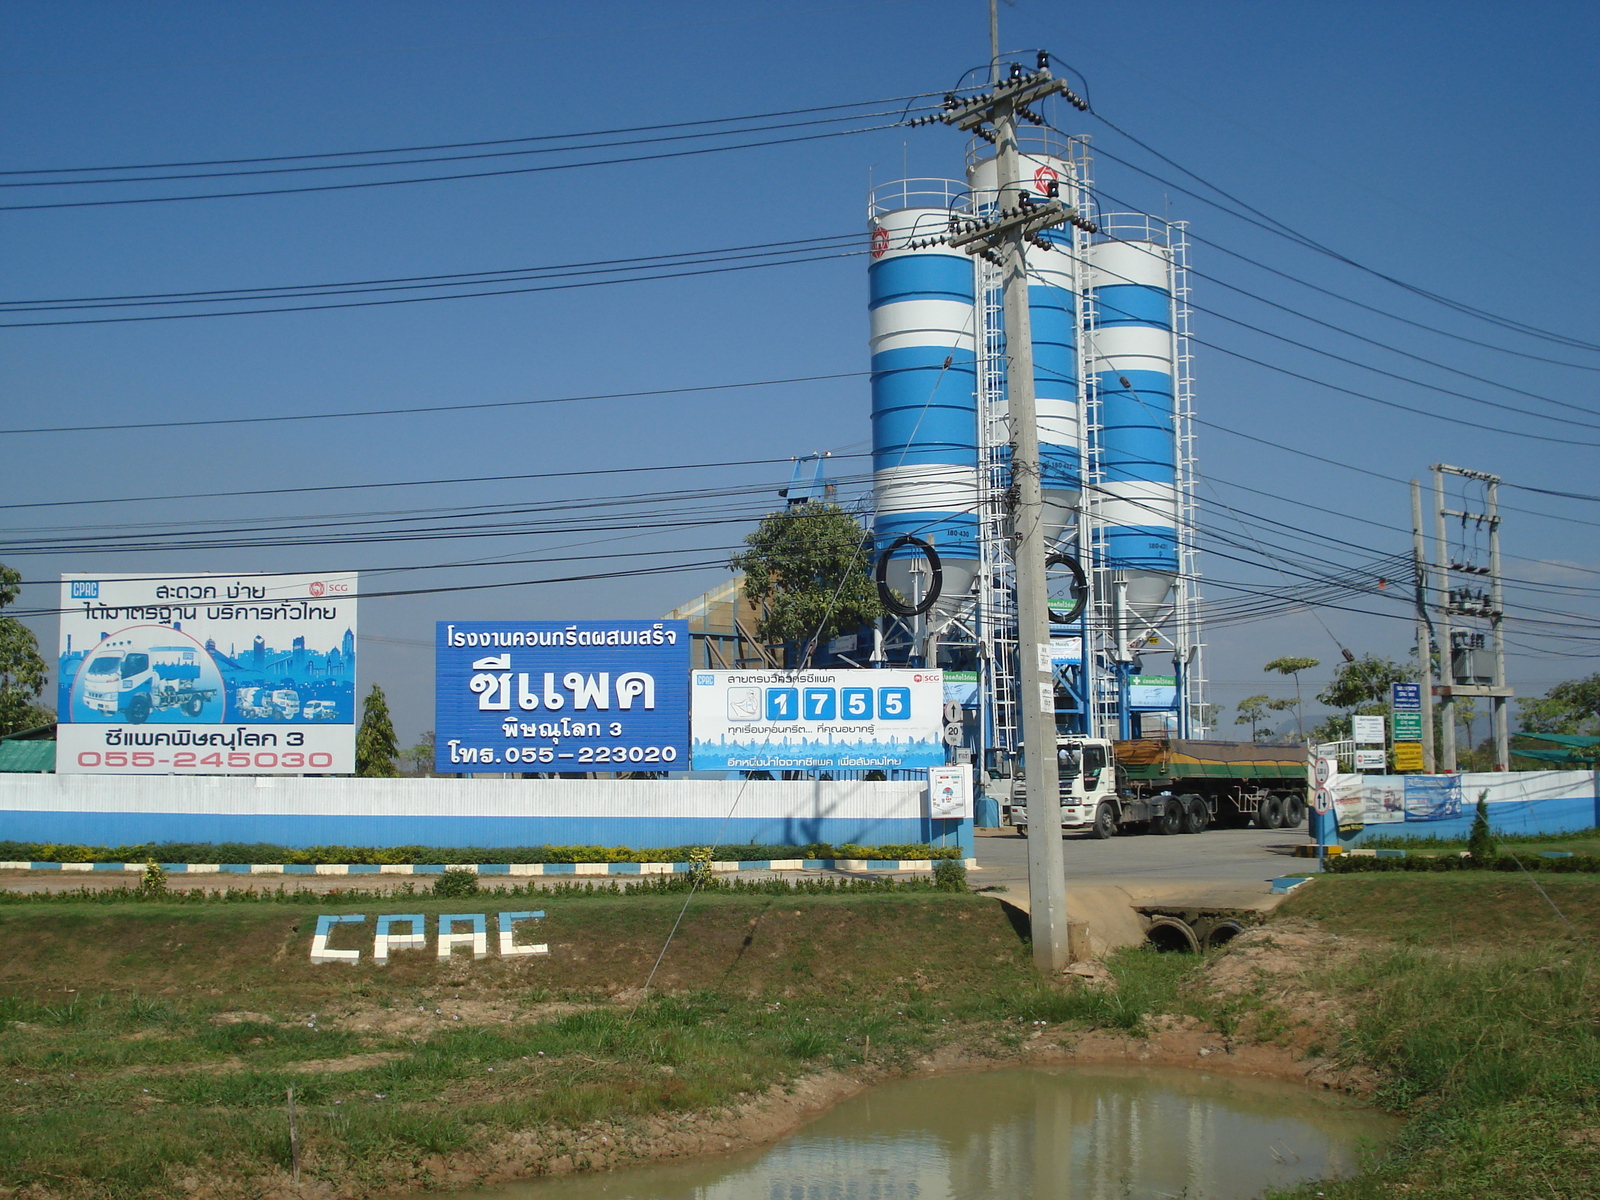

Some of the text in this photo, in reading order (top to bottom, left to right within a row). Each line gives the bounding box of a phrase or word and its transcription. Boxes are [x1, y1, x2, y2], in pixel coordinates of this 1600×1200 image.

[73, 581, 98, 597] CPAC
[156, 581, 266, 599] สะดวก ง่าย
[328, 584, 348, 592] SCG
[83, 598, 337, 624] ได้มาตรฐาน บริการทั่วไทย
[447, 623, 677, 647] โรงงานคอนกรีตผสมเสร็จ
[469, 653, 655, 711] ซีแพค
[697, 675, 715, 685] CPAC
[105, 727, 304, 751] ซีแพคพิษณุโลก 3
[502, 716, 622, 745] พิษณุโลก 3
[948, 726, 959, 736] 20
[77, 751, 333, 768] 055-245030
[310, 910, 549, 965] CPAC
